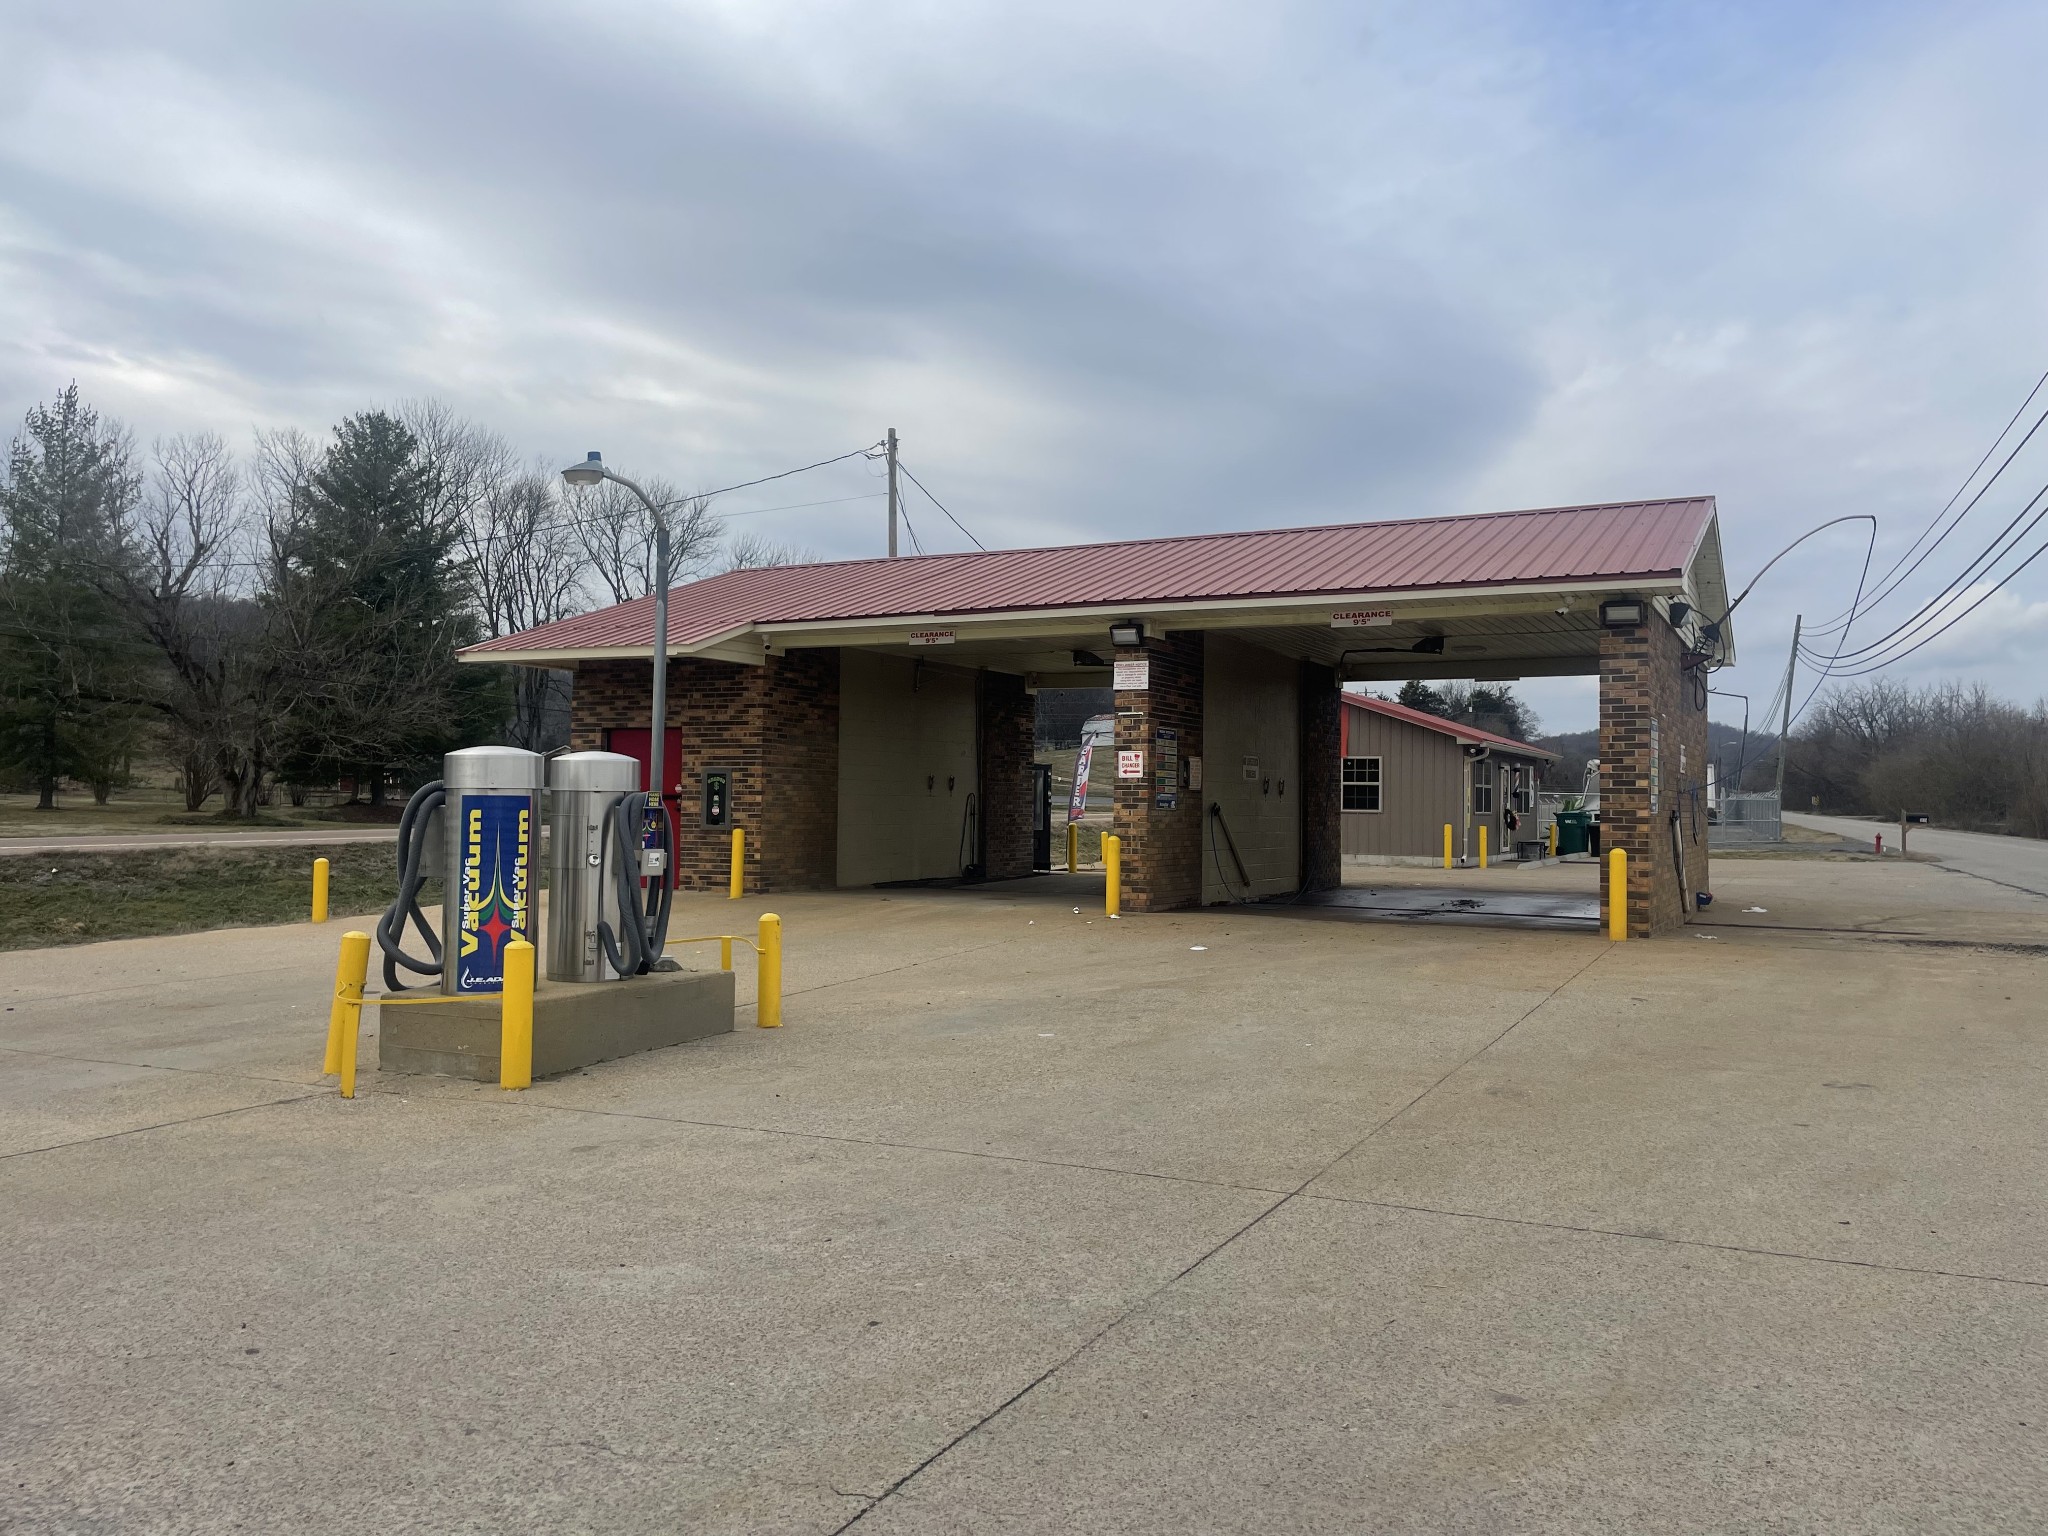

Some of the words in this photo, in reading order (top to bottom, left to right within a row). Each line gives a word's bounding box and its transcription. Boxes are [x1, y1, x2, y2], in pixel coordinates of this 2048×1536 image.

[1333, 611, 1391, 619] CLEARANCE
[461, 809, 482, 958] Vacuum
[463, 858, 471, 885] Vac
[512, 857, 520, 885] Vac
